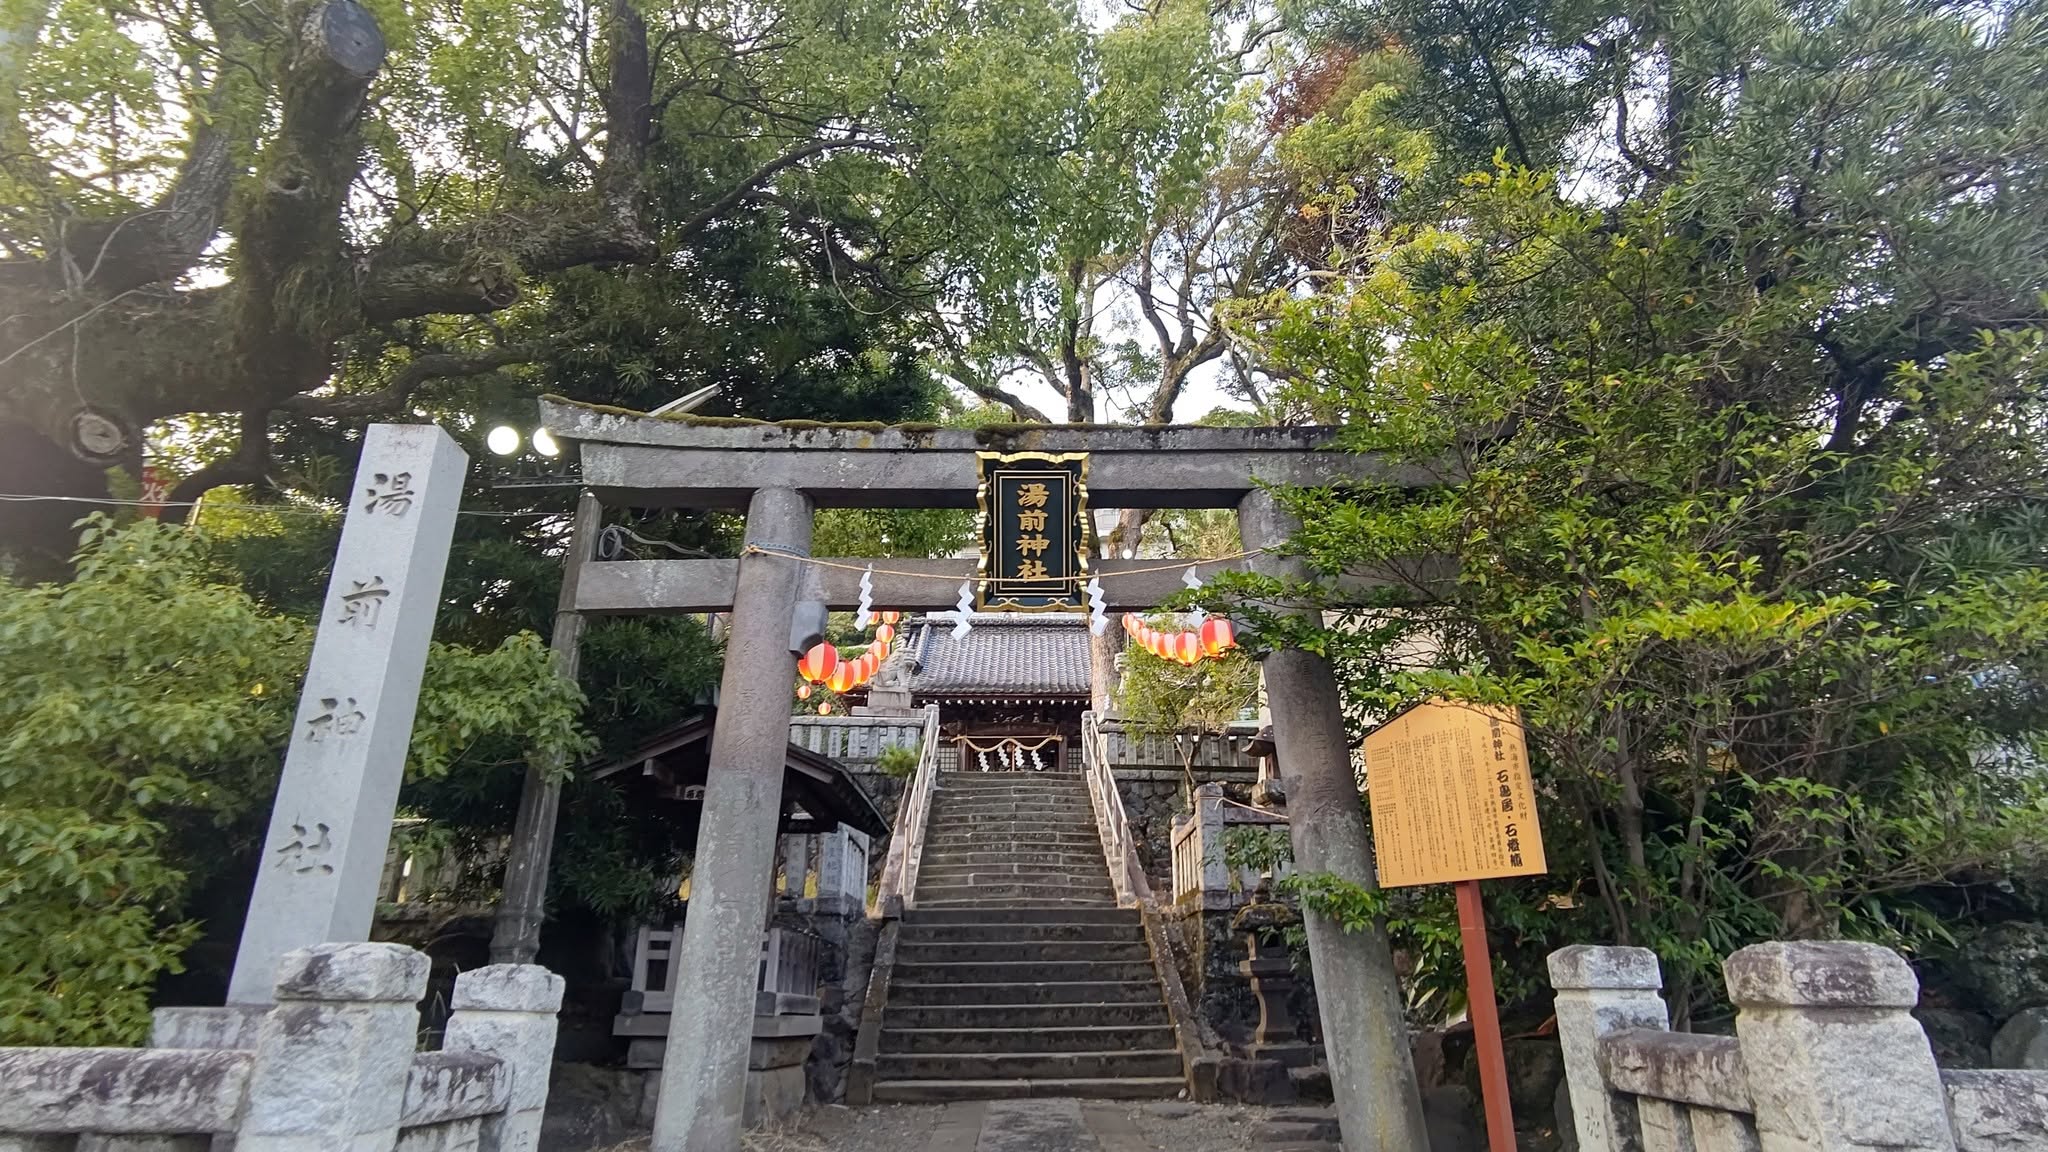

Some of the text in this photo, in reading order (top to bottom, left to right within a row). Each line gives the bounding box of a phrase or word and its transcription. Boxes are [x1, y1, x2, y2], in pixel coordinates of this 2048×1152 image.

[1016, 483, 1050, 583] 湯前神社
[275, 472, 415, 875] 湯前神社
